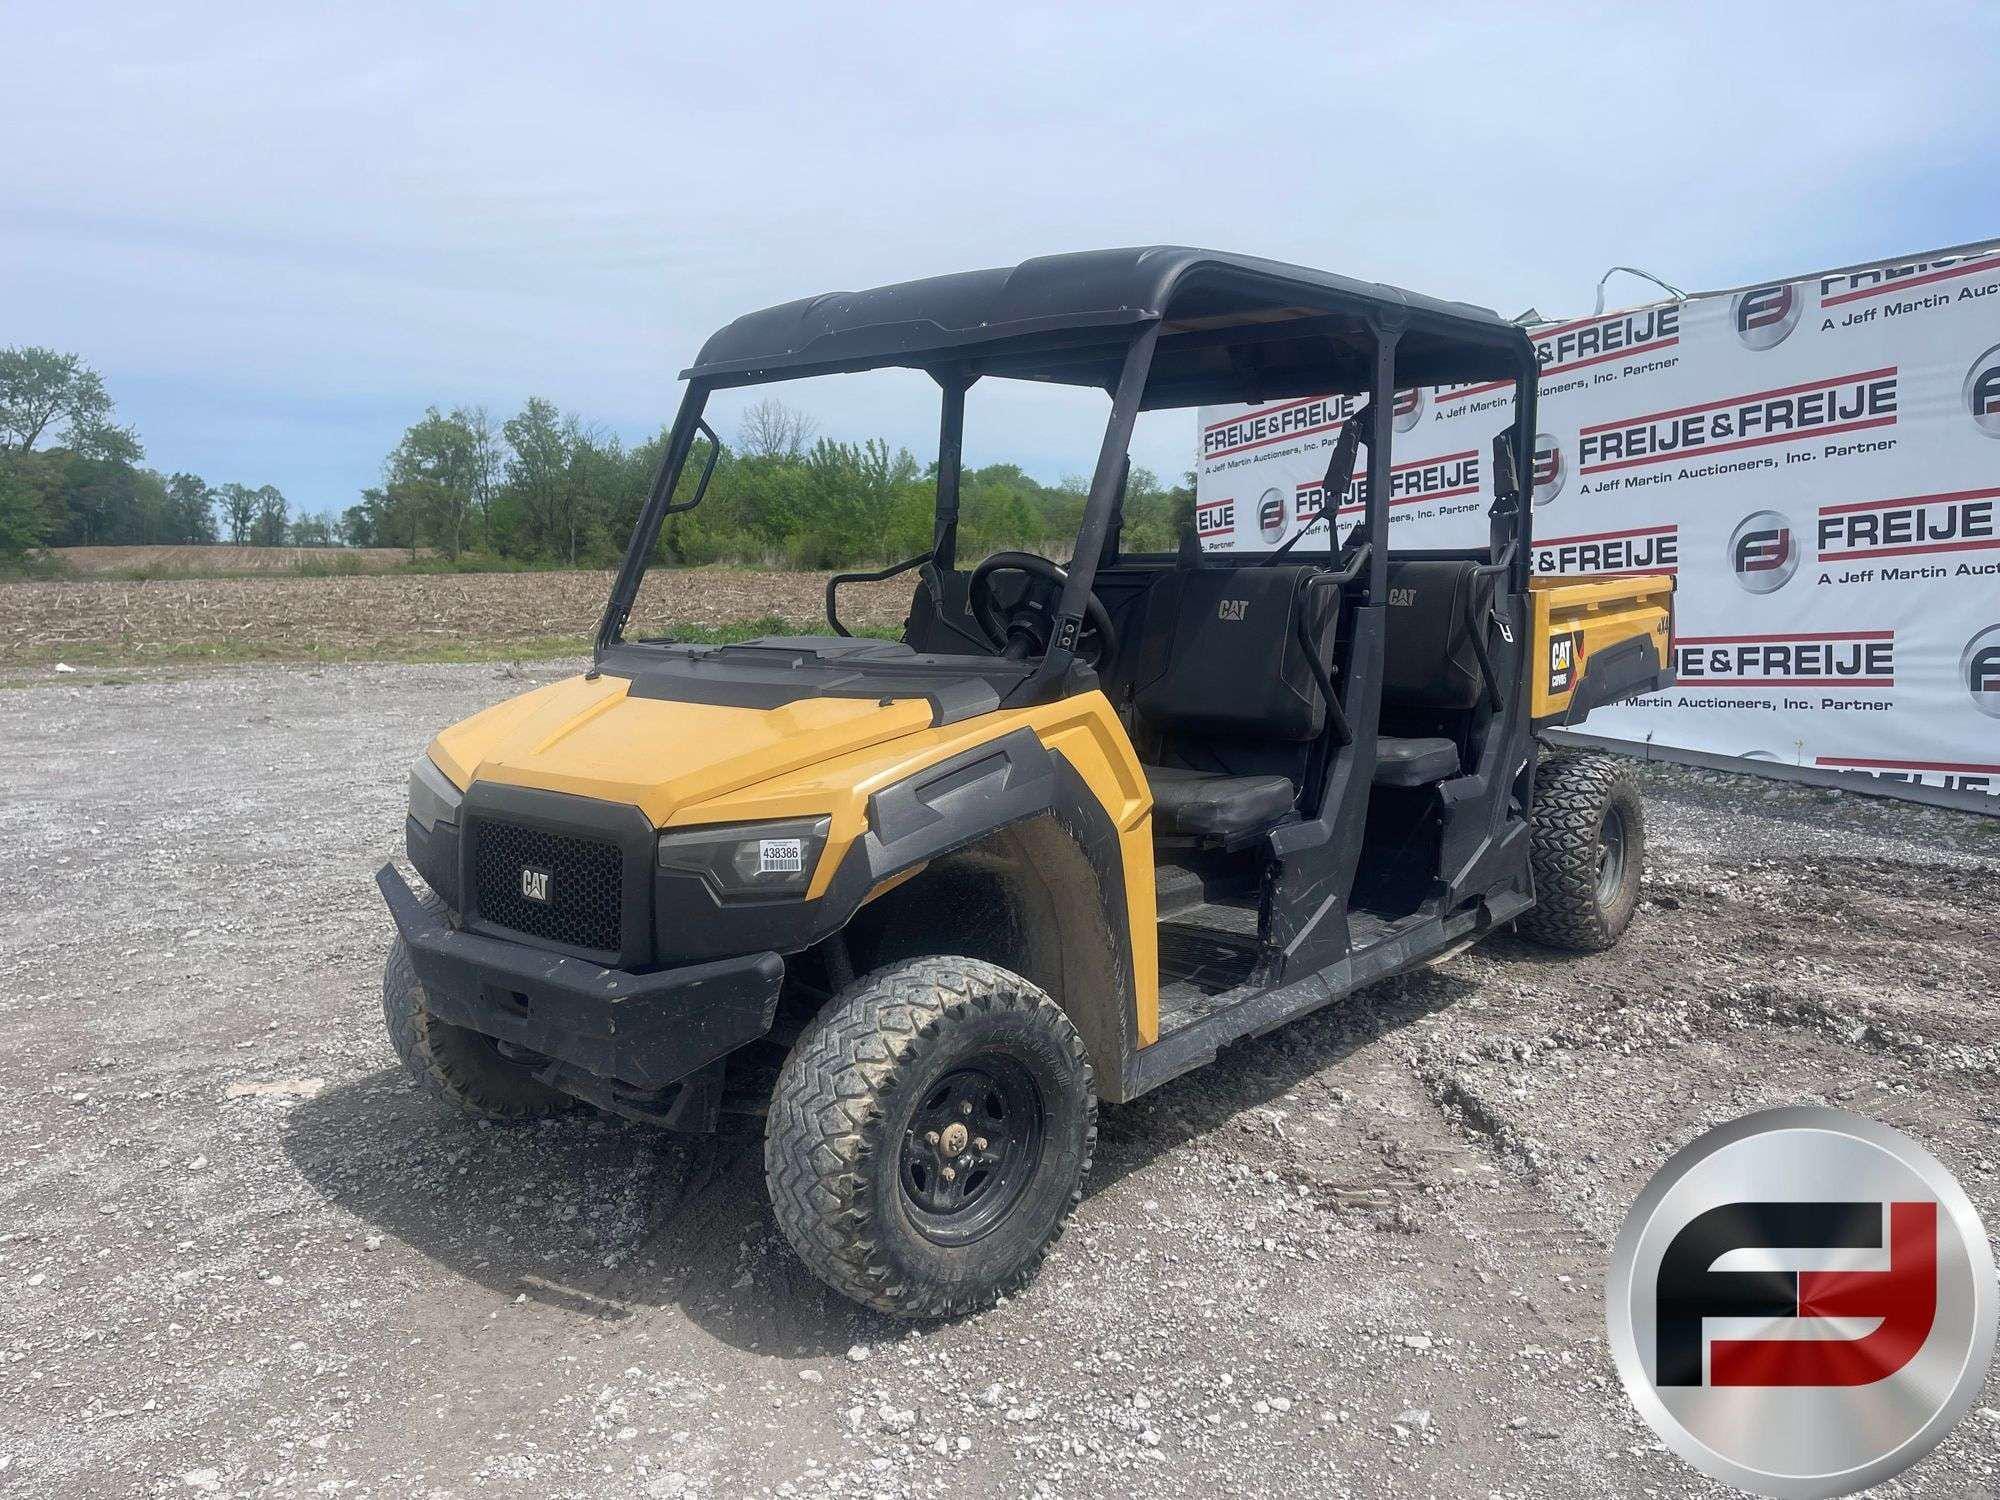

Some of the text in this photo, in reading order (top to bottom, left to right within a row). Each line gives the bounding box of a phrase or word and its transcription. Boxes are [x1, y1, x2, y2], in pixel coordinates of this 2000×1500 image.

[1821, 283, 2000, 331] A Jeff Martin Auc
[1594, 372, 1617, 384] Inc.
[1623, 357, 1679, 377] Partner
[1435, 411, 1444, 421] A
[1446, 405, 1467, 418] Jeff
[1470, 397, 1507, 412] Martin
[1227, 458, 1251, 468] Martin
[1580, 440, 1897, 495] A Jeff Martin Auctioneers, Inc. Partner
[1418, 509, 1436, 519] Inc.
[1440, 503, 1480, 515] Partner
[1818, 502, 1992, 549] FREIJE
[1818, 573, 1832, 585] A
[1839, 570, 1873, 584] Jeff
[1881, 566, 1947, 580] Martin
[1389, 588, 1417, 606] CAT
[1218, 600, 1250, 620] CAT
[1552, 640, 1571, 671] CAT
[1625, 697, 1672, 708] Martin
[1677, 697, 1777, 711] Auctioneers,
[1784, 699, 1813, 710] Inc.
[1821, 698, 1894, 711] Partner
[763, 847, 798, 859] 438386
[523, 870, 548, 900] CAT
